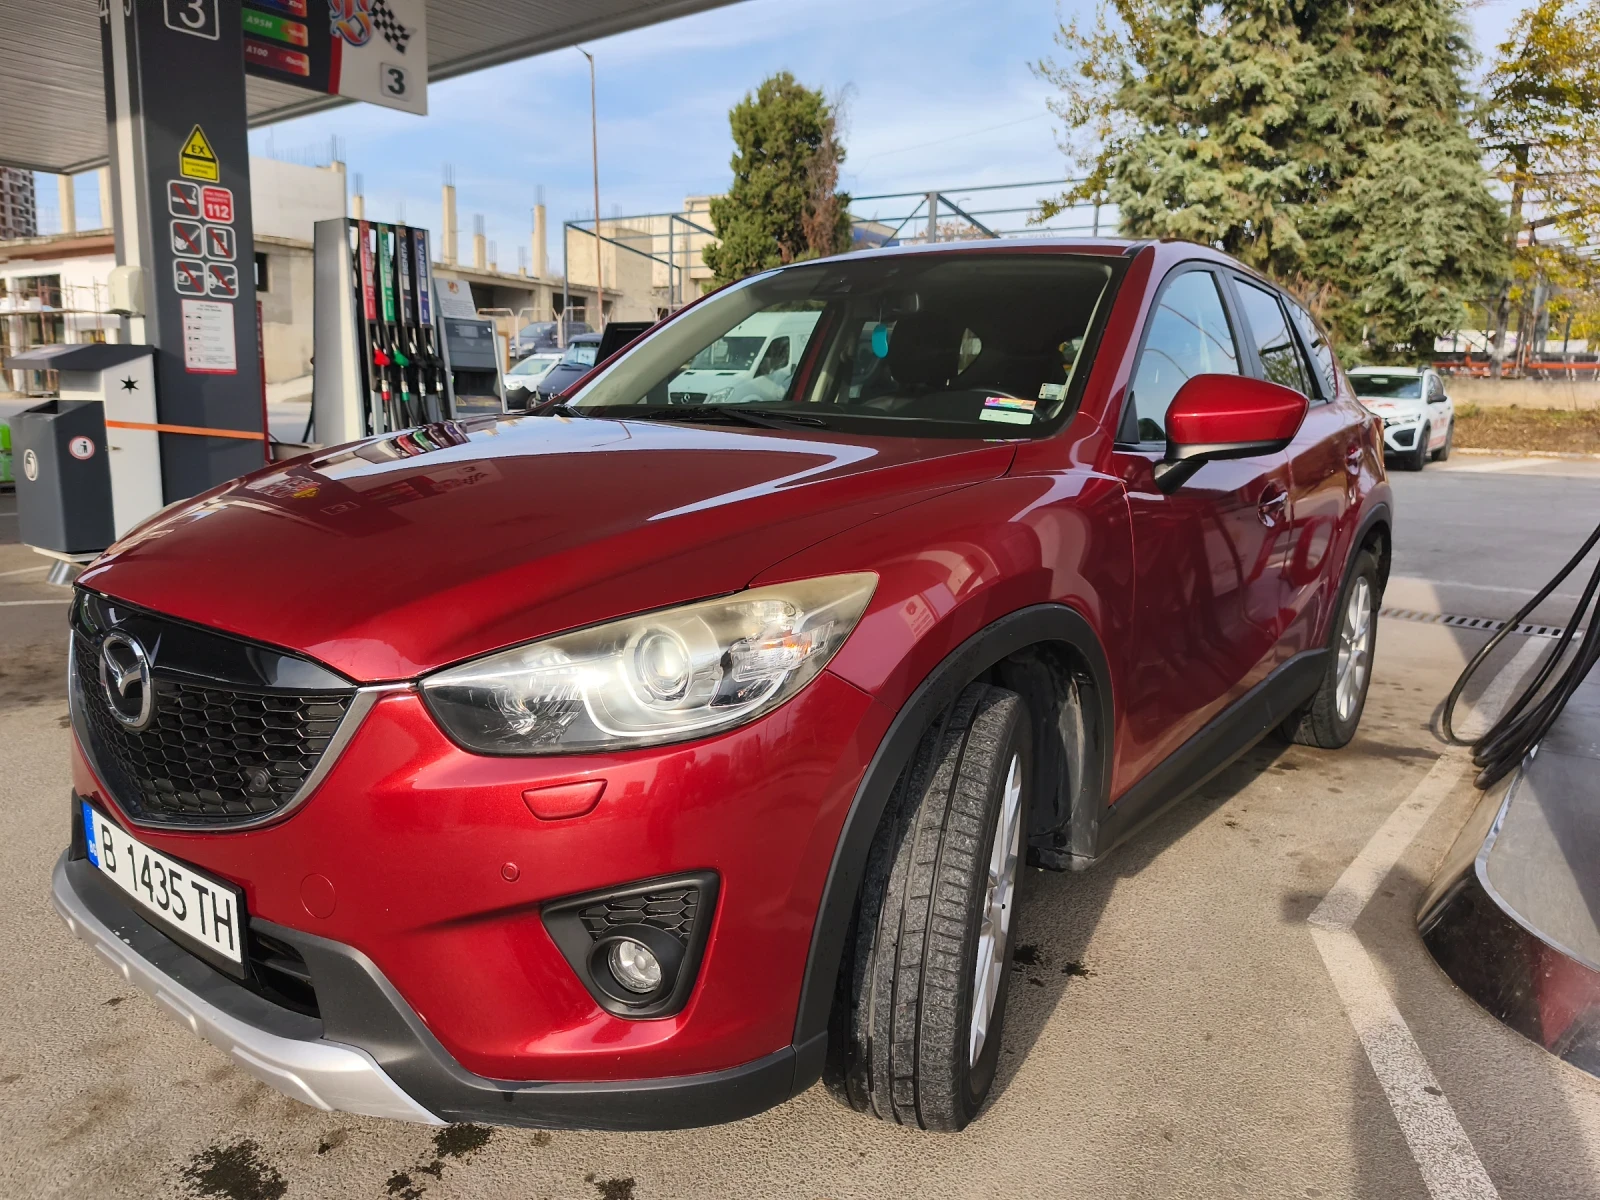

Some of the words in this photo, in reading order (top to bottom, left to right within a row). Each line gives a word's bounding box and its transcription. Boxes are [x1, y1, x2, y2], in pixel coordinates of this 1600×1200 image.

[179, 0, 206, 29] 3
[246, 45, 268, 57] A100
[387, 68, 405, 95] 3
[191, 144, 206, 155] EX
[207, 204, 230, 218] 112
[401, 241, 409, 275] BENITA
[418, 243, 427, 277] BENITA
[101, 823, 116, 873] B
[127, 844, 187, 921] 1435
[191, 880, 235, 951] TH
